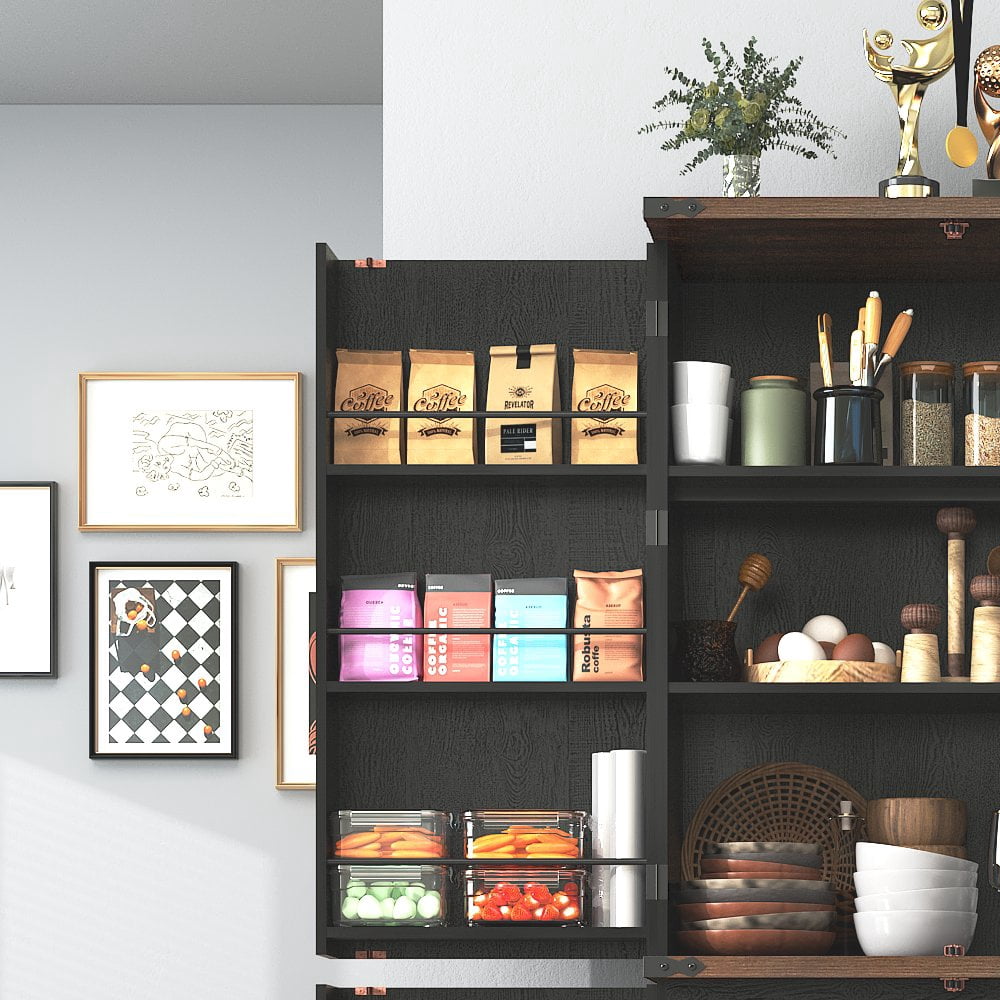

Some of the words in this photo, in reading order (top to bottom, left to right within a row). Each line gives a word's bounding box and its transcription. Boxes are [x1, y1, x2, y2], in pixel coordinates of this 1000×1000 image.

[341, 391, 394, 412] Coffee
[414, 391, 467, 412] Coffee
[504, 400, 534, 410] REVELATOR
[577, 391, 631, 412] Coffee
